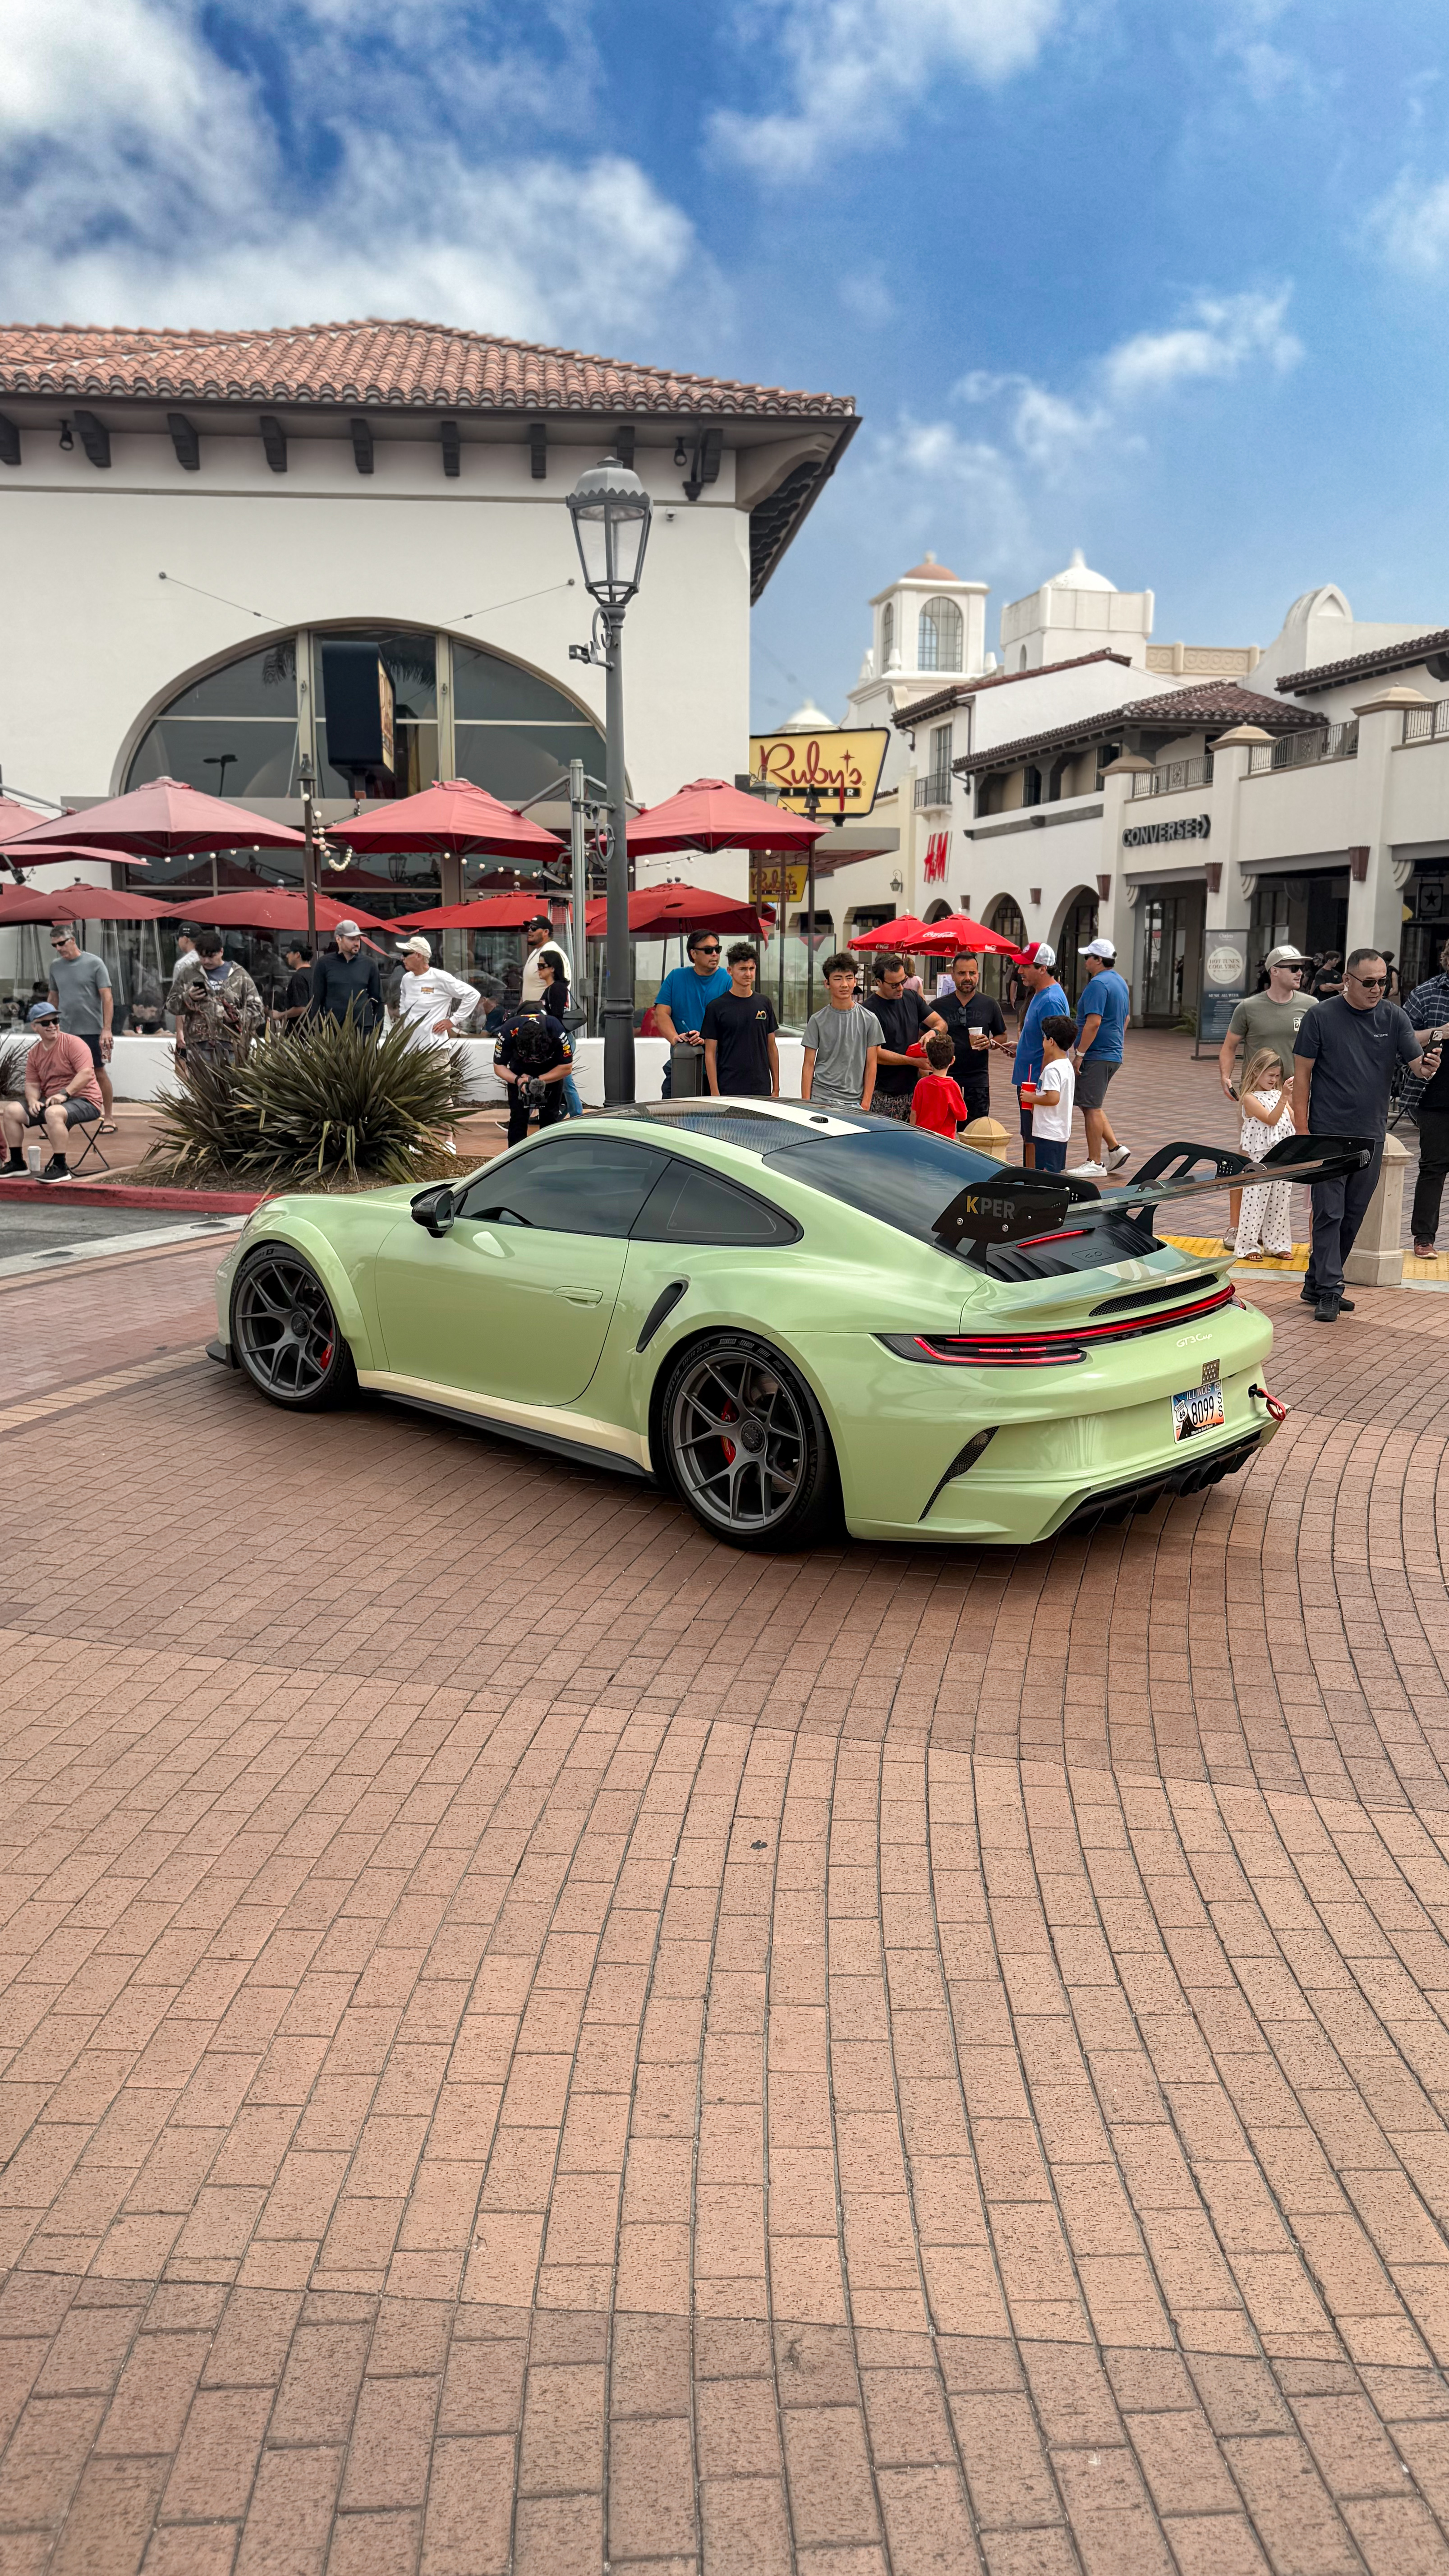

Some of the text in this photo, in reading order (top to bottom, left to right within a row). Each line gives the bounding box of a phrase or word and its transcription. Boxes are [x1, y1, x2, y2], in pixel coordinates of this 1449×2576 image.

[760, 741, 862, 812] Ruby's
[1122, 818, 1197, 847] CONVERSE
[966, 1195, 1015, 1219] KPER
[1187, 1384, 1211, 1400] ILLINOIS
[1180, 1409, 1186, 1419] 66
[1191, 1396, 1214, 1425] 8099
